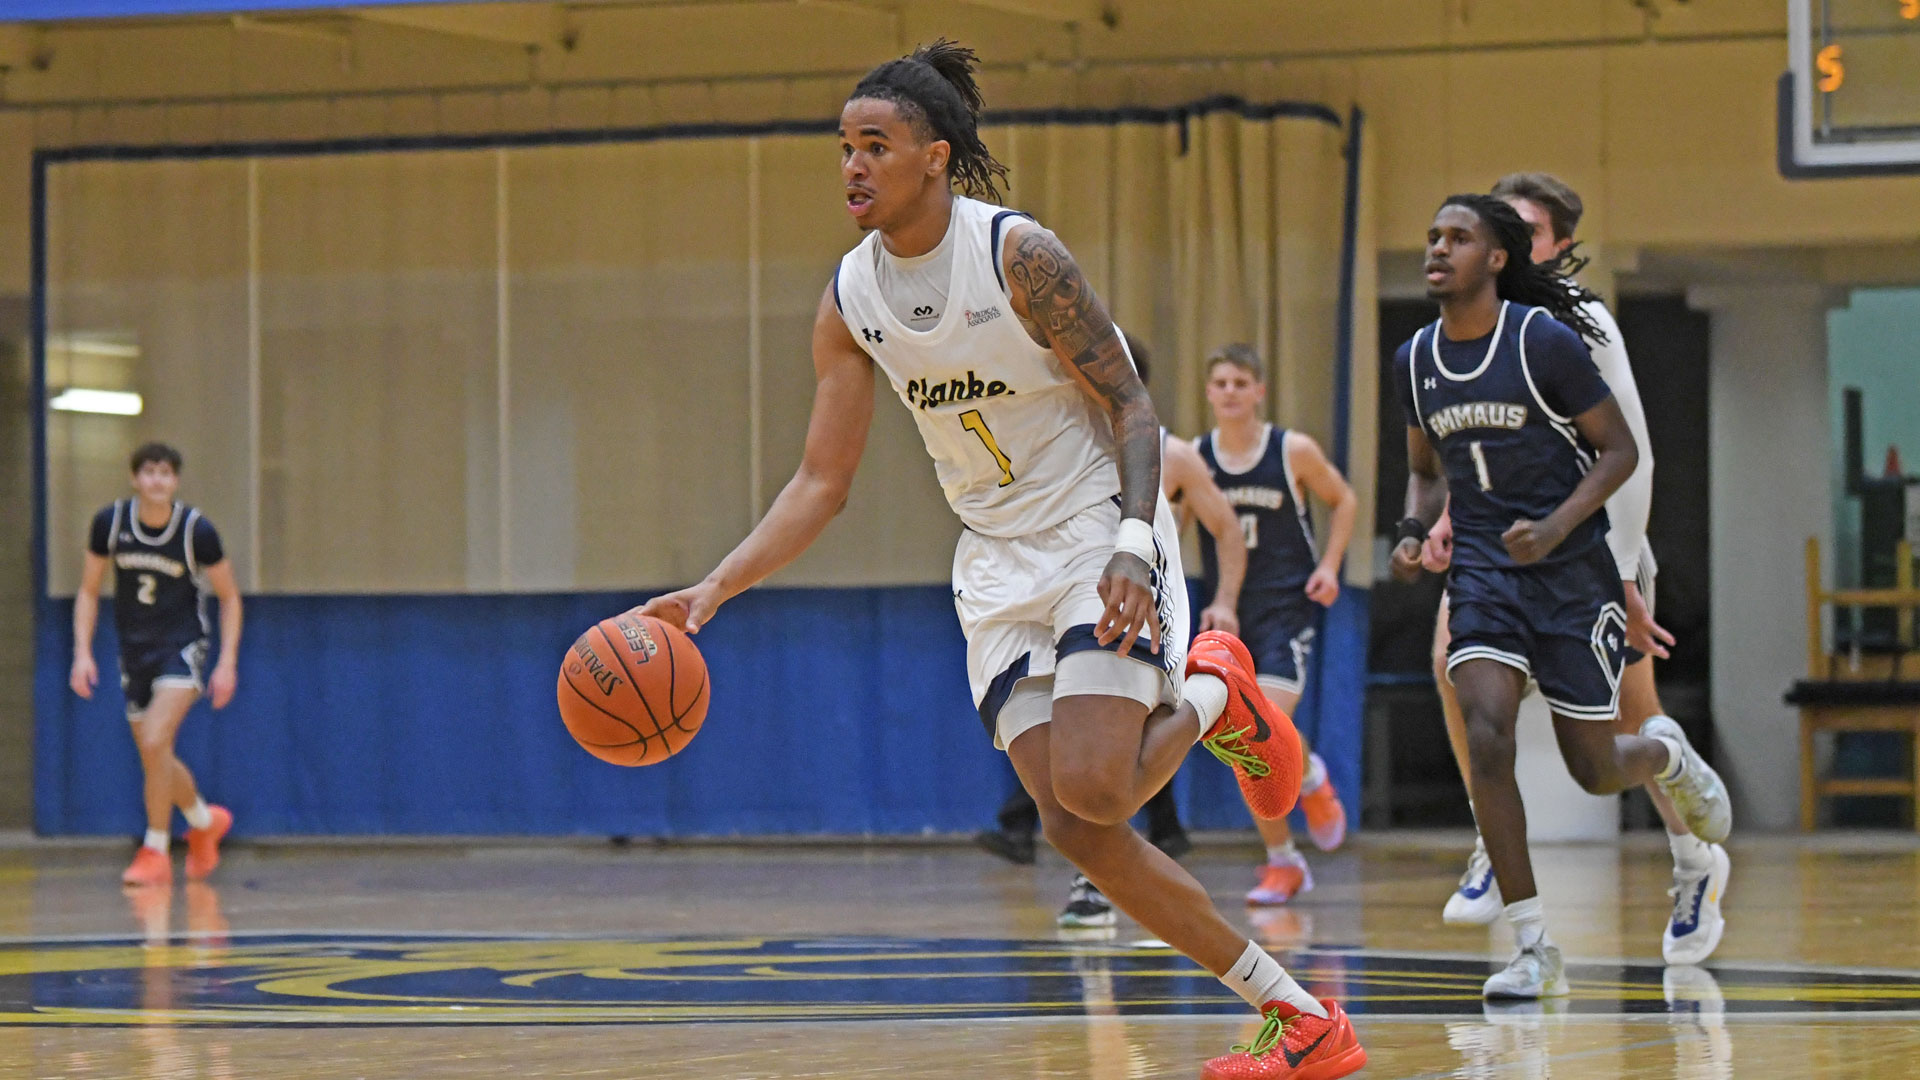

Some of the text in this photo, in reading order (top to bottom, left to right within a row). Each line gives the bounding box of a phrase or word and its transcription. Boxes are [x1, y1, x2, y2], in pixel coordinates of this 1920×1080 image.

[1428, 402, 1528, 440] EMMAUS
[958, 409, 1015, 488] 1
[1470, 440, 1493, 492] 1
[137, 574, 156, 605] 2
